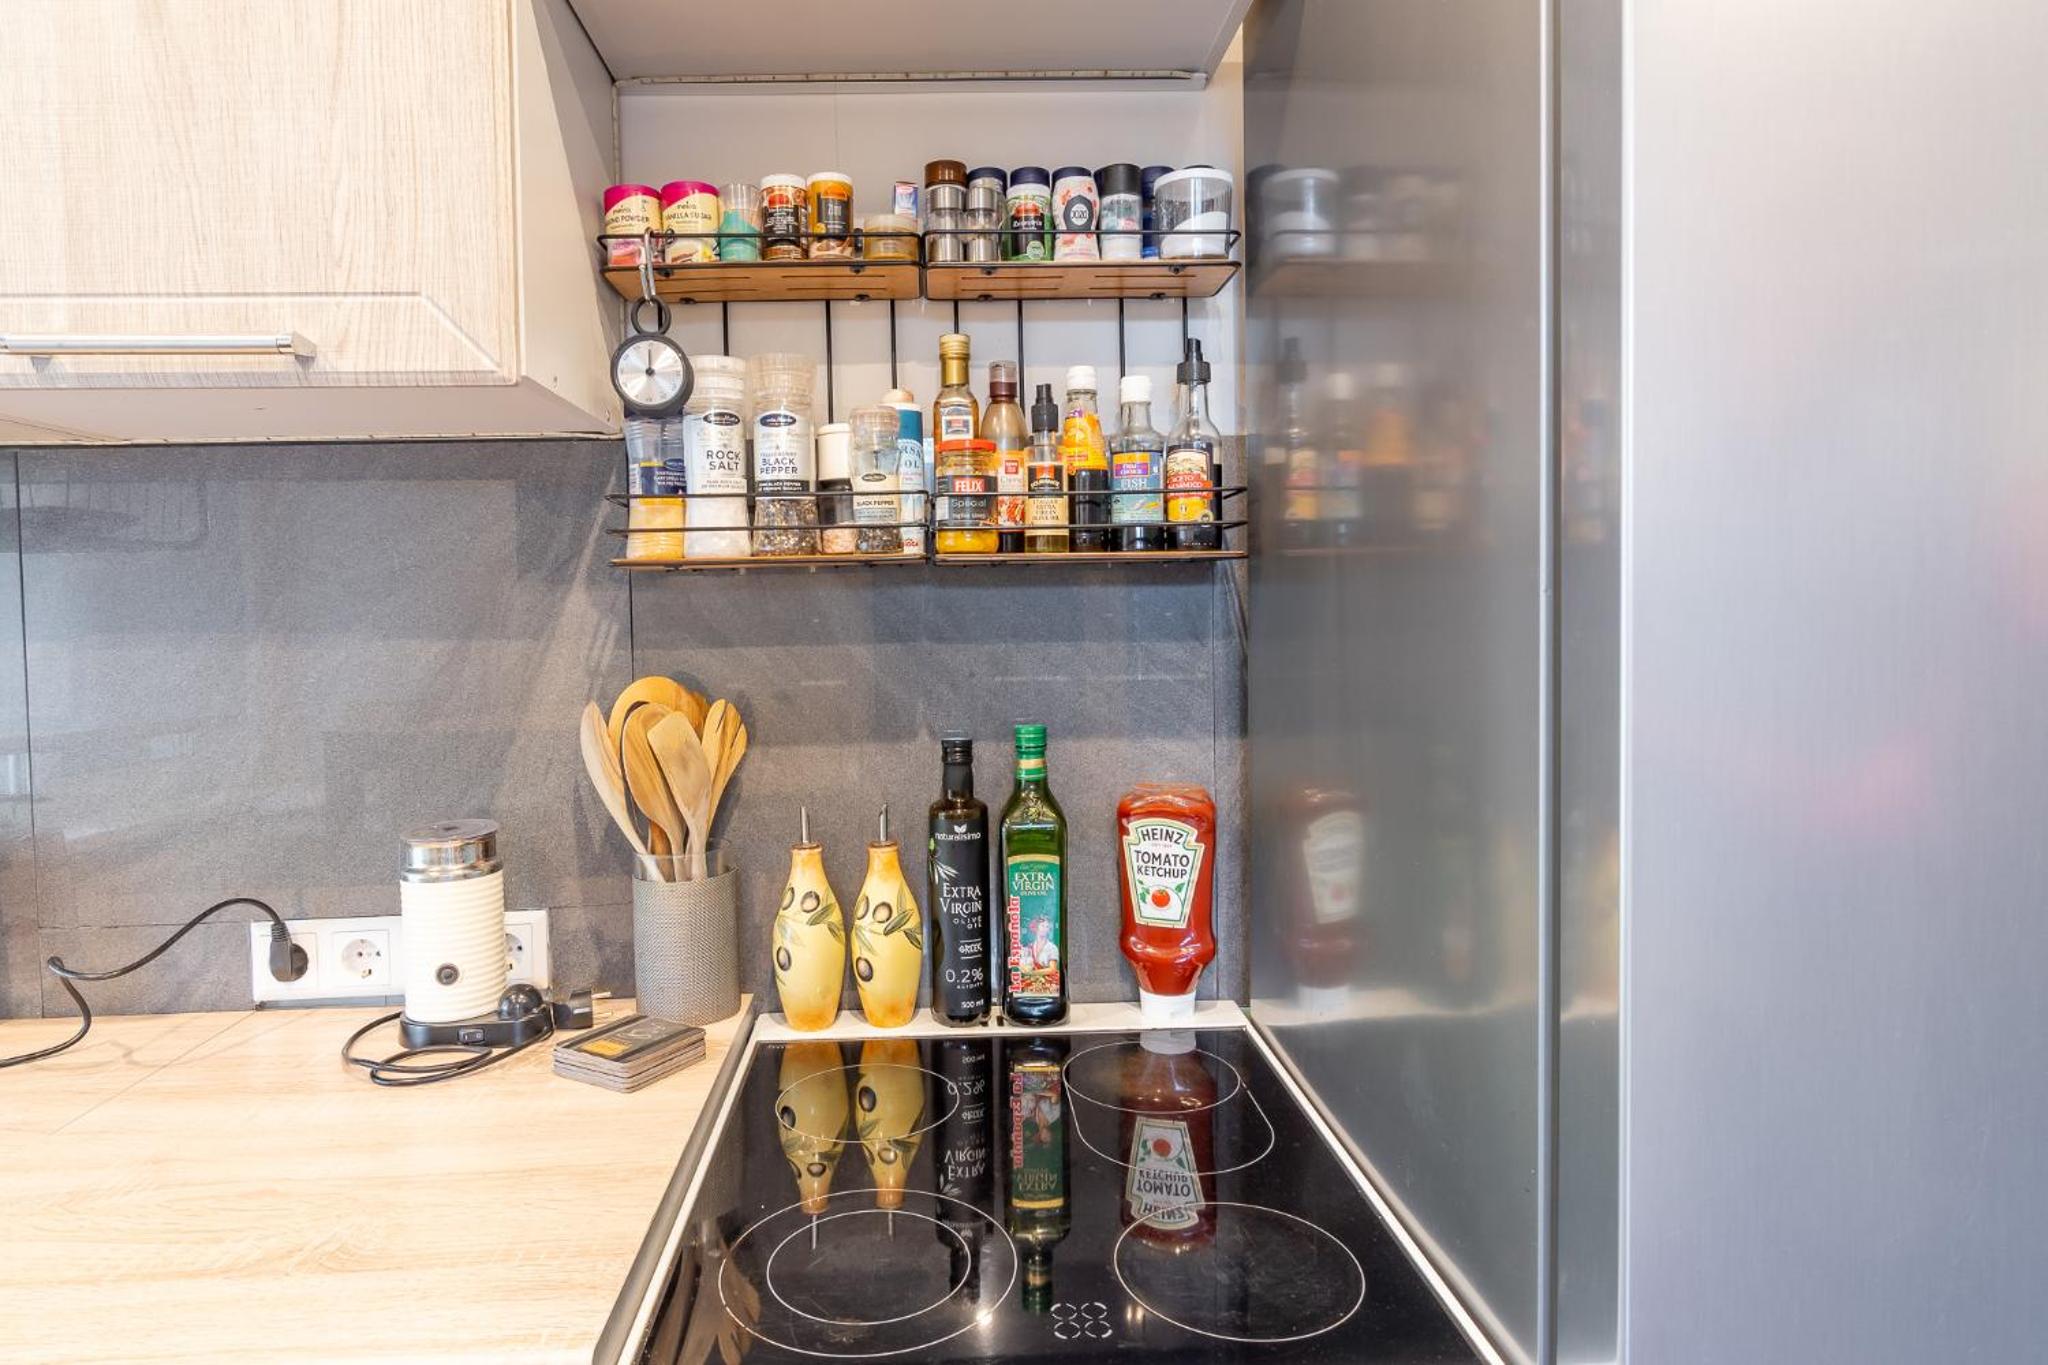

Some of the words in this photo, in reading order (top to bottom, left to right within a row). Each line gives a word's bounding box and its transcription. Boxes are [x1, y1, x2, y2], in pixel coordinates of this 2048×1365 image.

[706, 449, 741, 461] ROCK
[761, 457, 796, 466] BLACK
[709, 461, 740, 471] SALT
[759, 466, 798, 475] PEPPER
[954, 479, 983, 492] FELIX
[1121, 478, 1148, 488] FISH
[1140, 827, 1184, 845] HEINZ
[1134, 850, 1190, 867] TOMATO
[1014, 872, 1054, 881] EXTRA
[1136, 865, 1188, 879] KETCHUP
[943, 882, 982, 900] EXTRA
[1012, 880, 1055, 892] VIRGIN
[939, 897, 983, 918] VIRGIN
[945, 968, 984, 983] 0.2%
[1009, 971, 1021, 993] La
